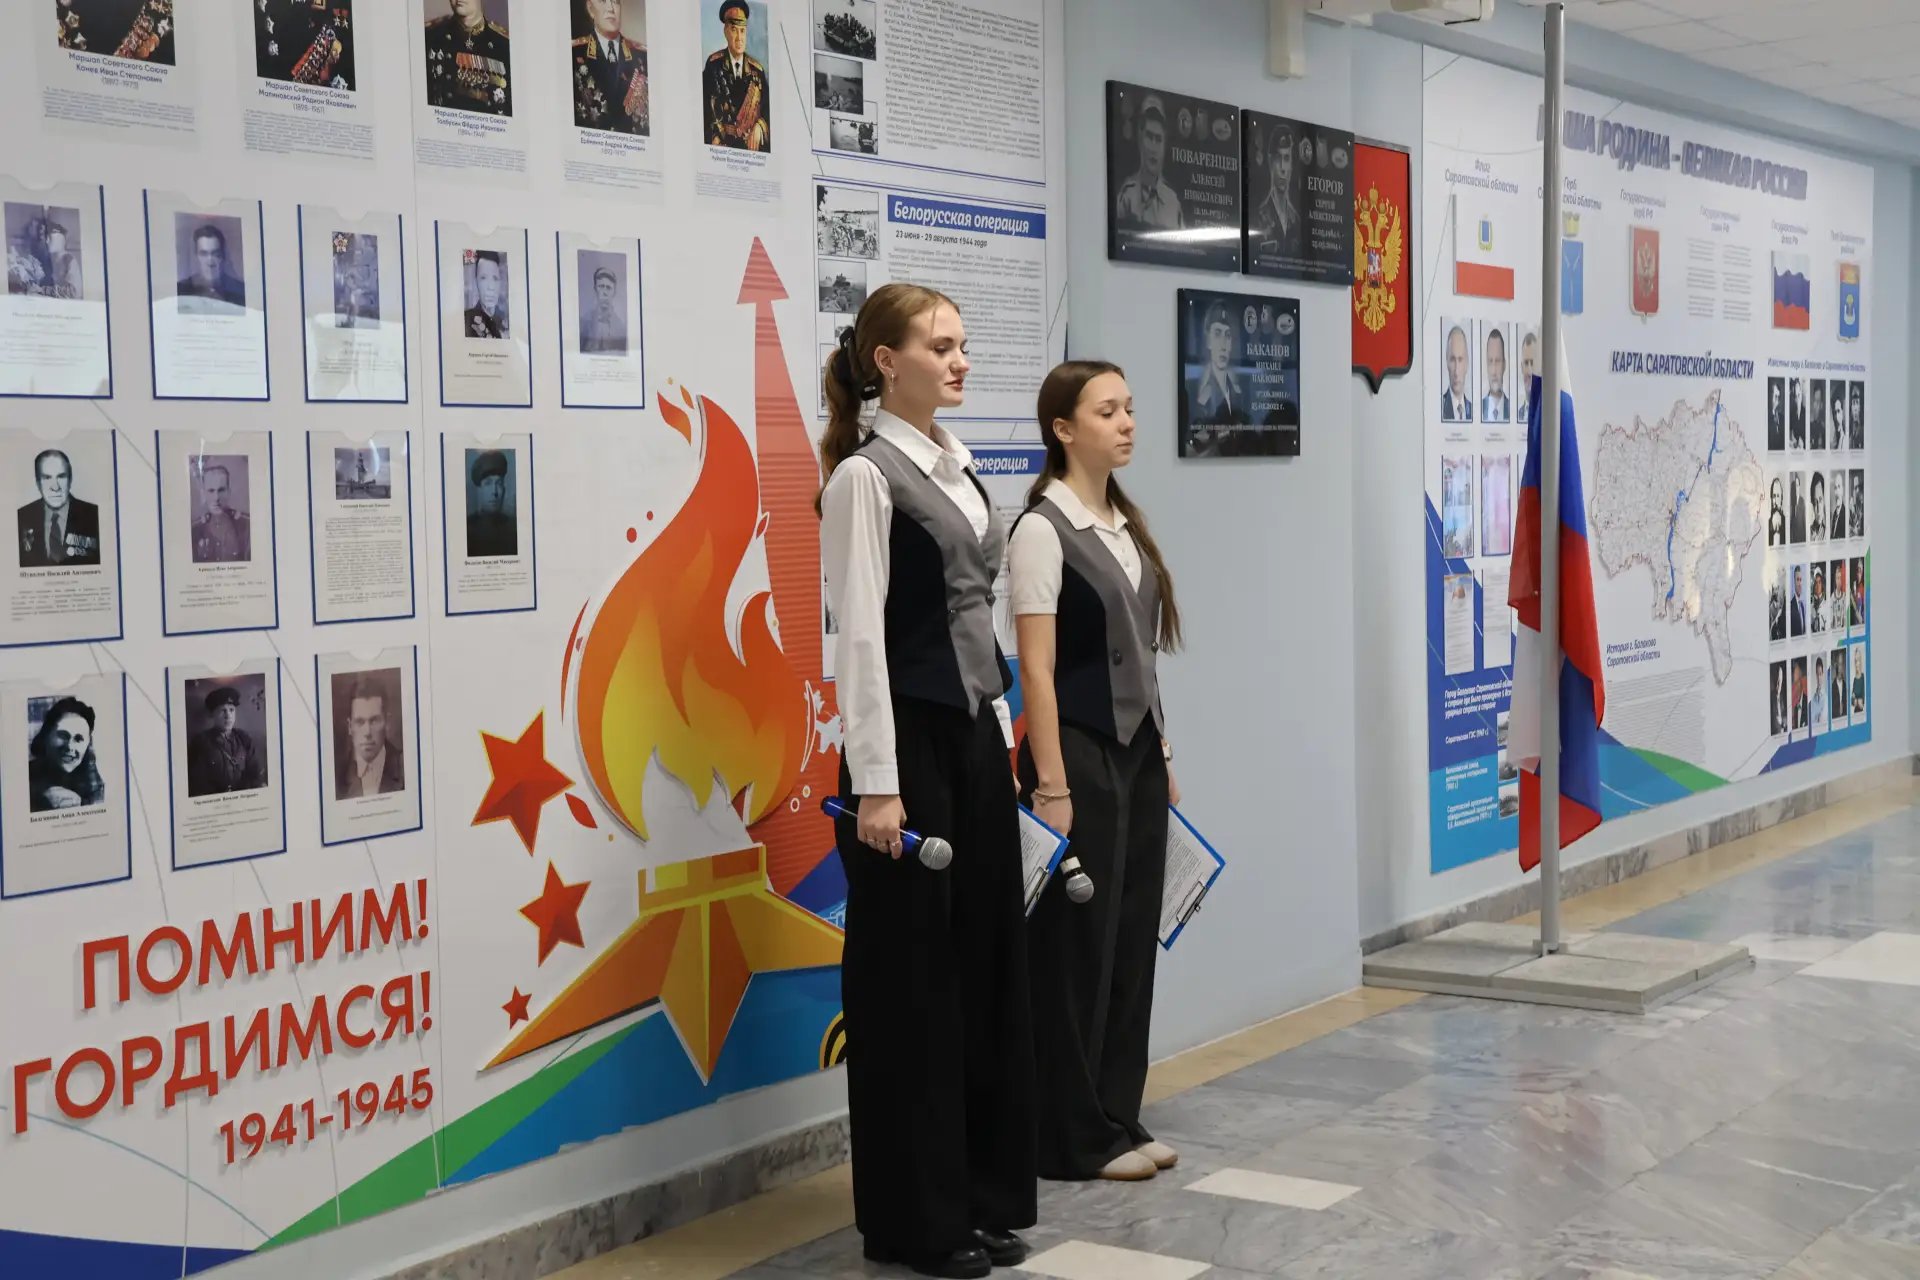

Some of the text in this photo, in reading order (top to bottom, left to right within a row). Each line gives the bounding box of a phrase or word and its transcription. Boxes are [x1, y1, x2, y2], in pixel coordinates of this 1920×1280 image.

[69, 52, 168, 75] Маршал Советского Союза
[76, 64, 98, 74] Конев
[100, 67, 118, 77] Иван
[258, 89, 301, 101] Малиновский
[302, 95, 325, 105] Родион
[265, 81, 350, 99] Маршал Советского Союза
[434, 109, 507, 125] Маршал Советского Союза
[1596, 119, 1671, 172] РОДИНА
[1171, 147, 1238, 172] ПОВАРЕНЦЕВ
[1475, 158, 1491, 173] Флаг
[1191, 173, 1225, 188] АЛЕКСЕЙ
[1307, 176, 1344, 196] ЕГОРОВ
[1445, 168, 1519, 194] Саратовской области
[1563, 176, 1577, 190] Герб
[1577, 195, 1602, 210] области
[894, 201, 1029, 236] Белорусская операция
[895, 230, 903, 238] 23
[904, 232, 920, 240] июня
[924, 233, 932, 242] 29
[933, 235, 958, 245] августа
[959, 237, 973, 246] 1944
[974, 239, 988, 248] года
[1246, 343, 1290, 357] БАКАНОВ
[1612, 350, 1754, 379] КАРТА САРАТОВСКОЙ ОБЛАСТИ
[974, 457, 1029, 474] операция
[1606, 643, 1629, 654] История
[1634, 638, 1656, 649] Балаково
[1606, 650, 1660, 668] Саратовской области
[82, 878, 429, 1010] ПОМНИМ!
[14, 971, 432, 1134] ГОРДИМСЯ!
[219, 1067, 434, 1164] 1941-1945
